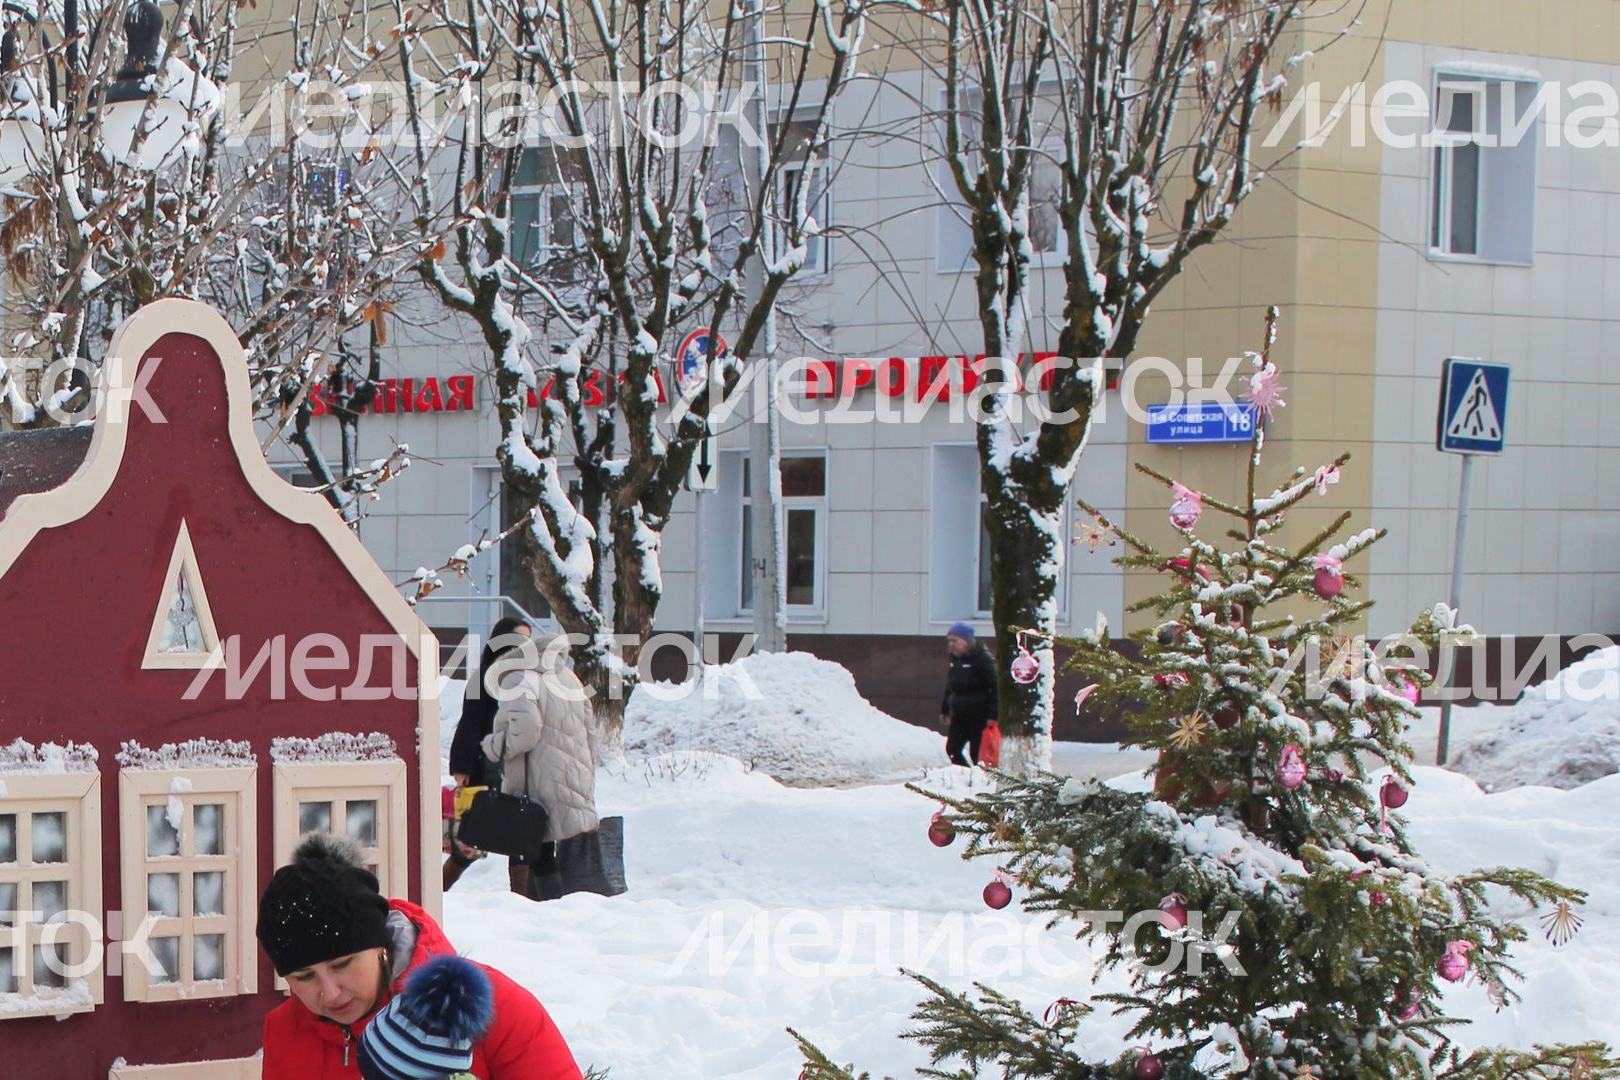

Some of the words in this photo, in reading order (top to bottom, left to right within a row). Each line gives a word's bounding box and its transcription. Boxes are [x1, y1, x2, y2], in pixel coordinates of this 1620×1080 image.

[1169, 411, 1224, 423] Советская
[1229, 412, 1251, 432] 18
[1170, 425, 1203, 436] улица
